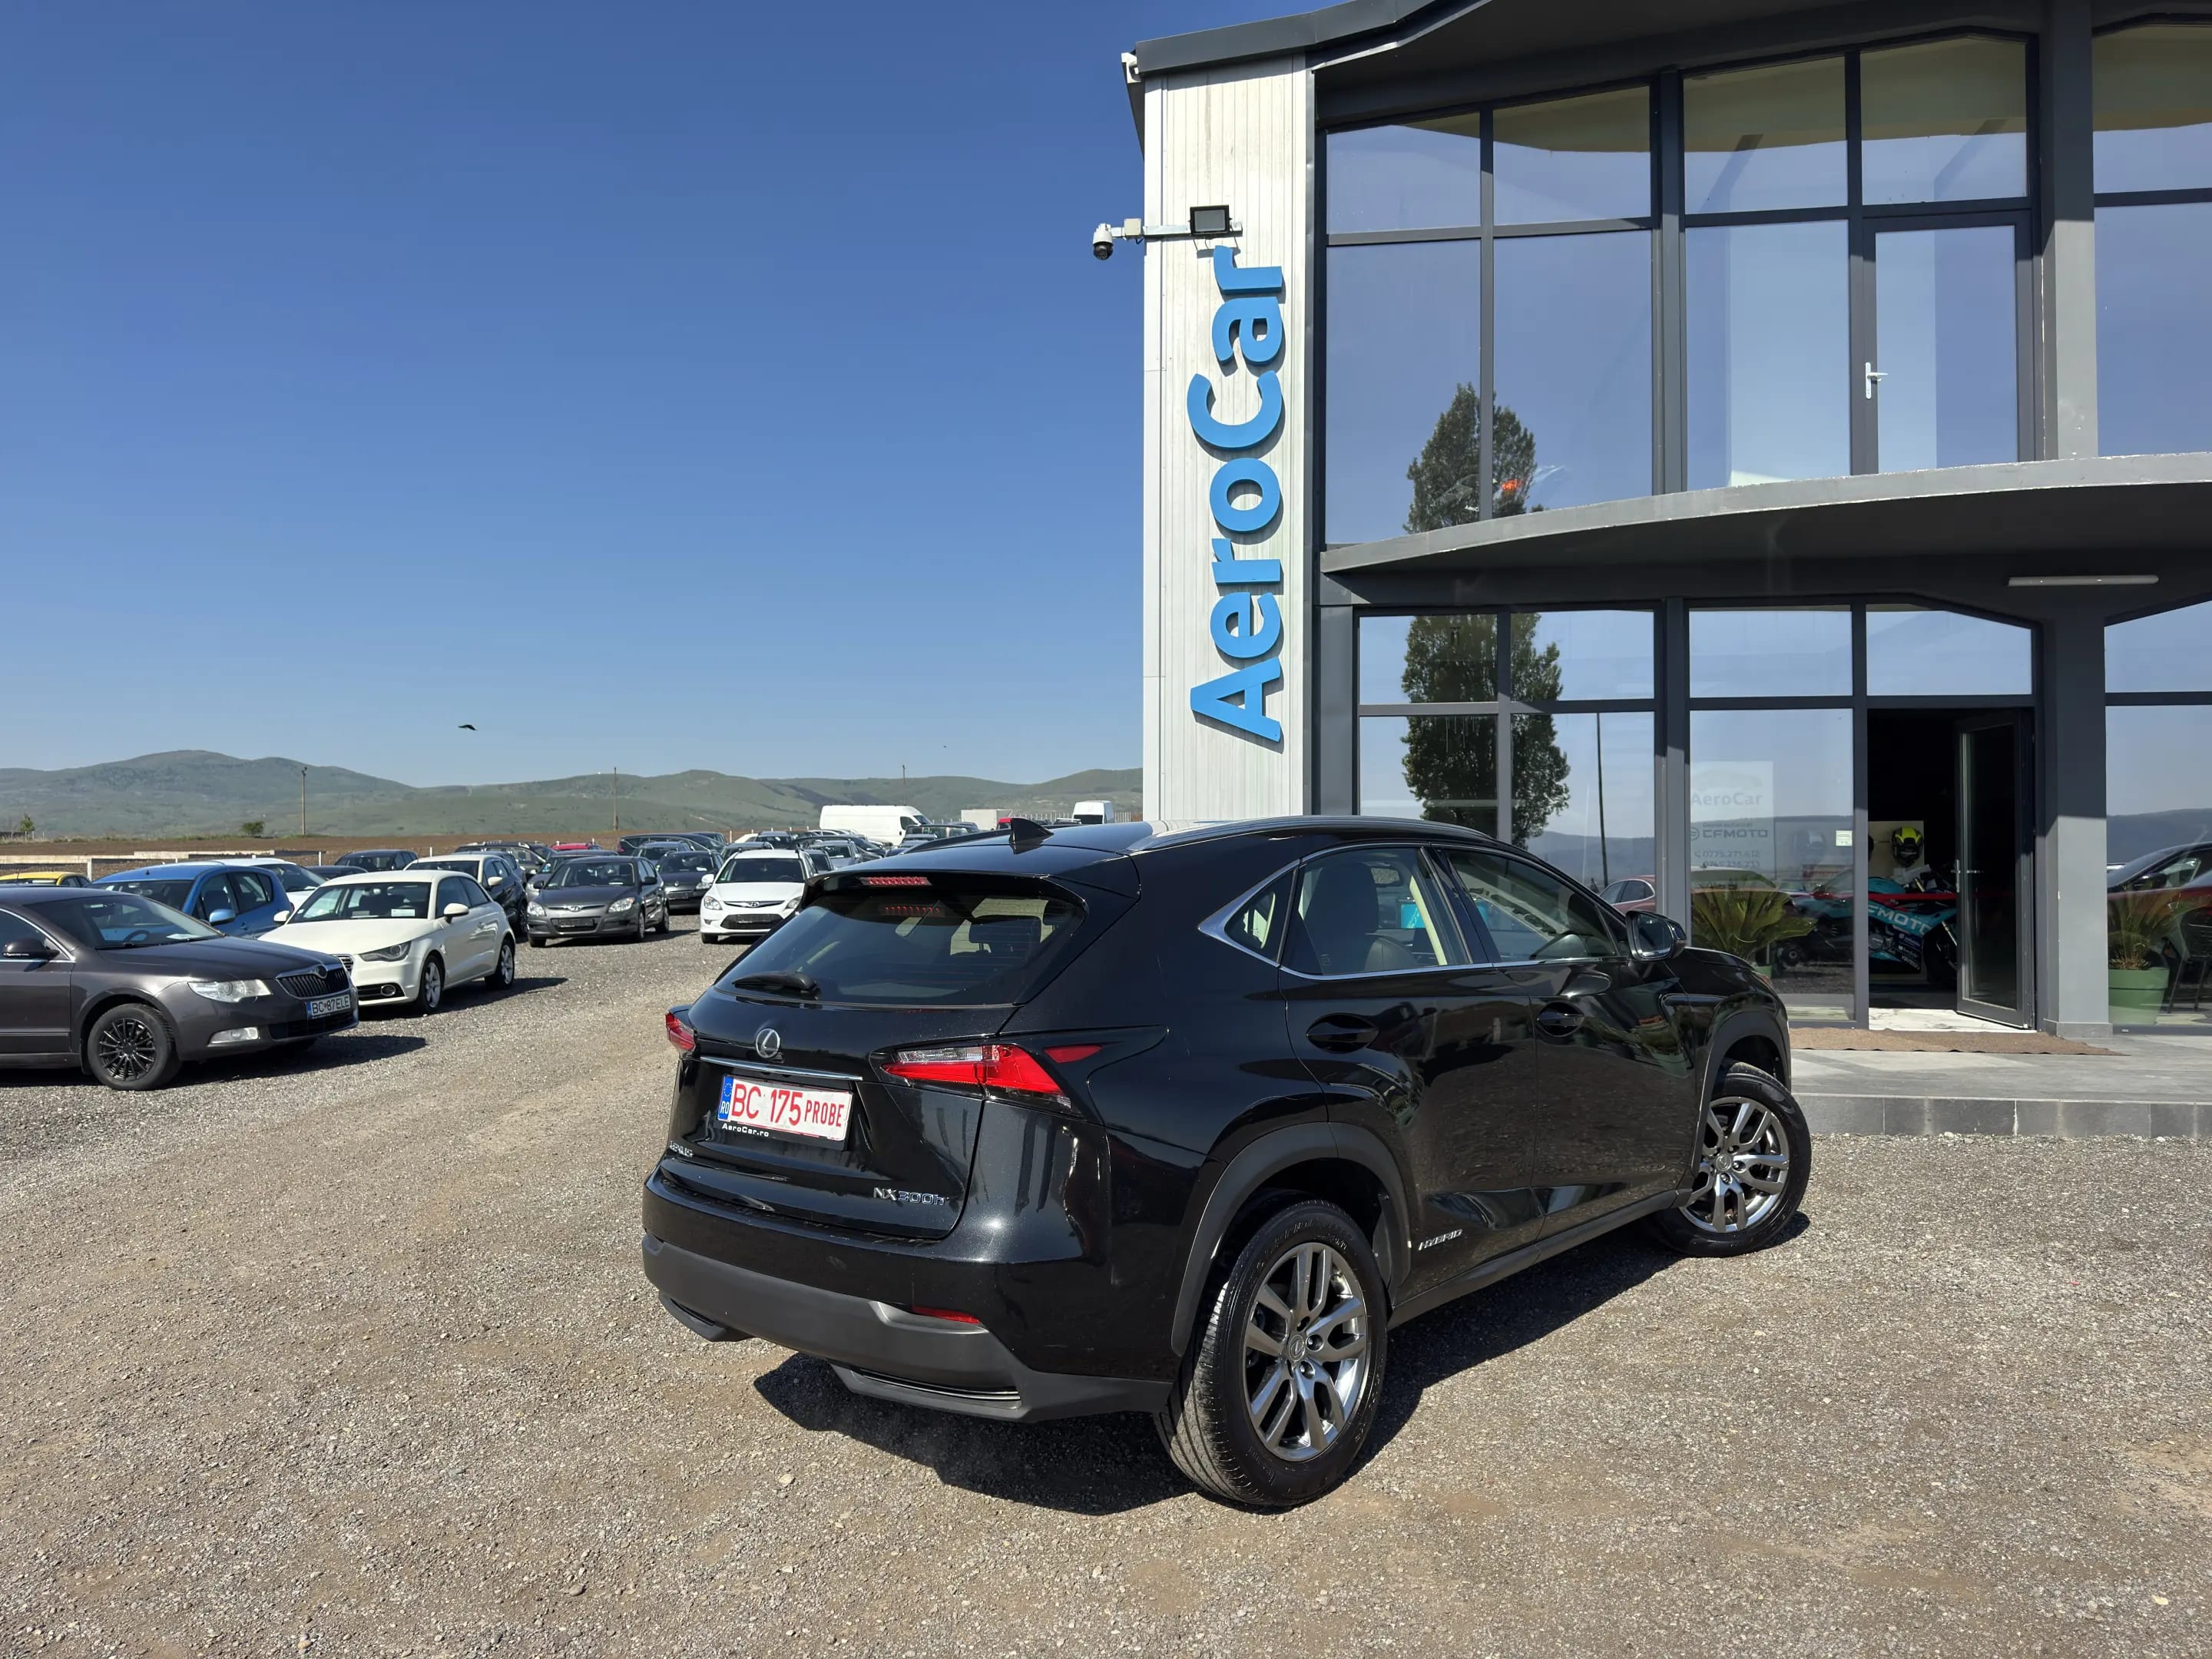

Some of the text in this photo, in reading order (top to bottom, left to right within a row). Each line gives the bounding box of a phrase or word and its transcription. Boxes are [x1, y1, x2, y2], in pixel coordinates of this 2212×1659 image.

[1187, 245, 1283, 743] AeroCar
[1691, 792, 1763, 806] AeroCar
[1703, 830, 1769, 839] CFMOTO
[312, 1002, 324, 1014] BC
[720, 1100, 730, 1114] RO
[731, 1083, 845, 1128] BC 175 PROBE
[722, 1122, 770, 1137] AeroCar.ro
[1418, 1229, 1463, 1251] HYBRID
